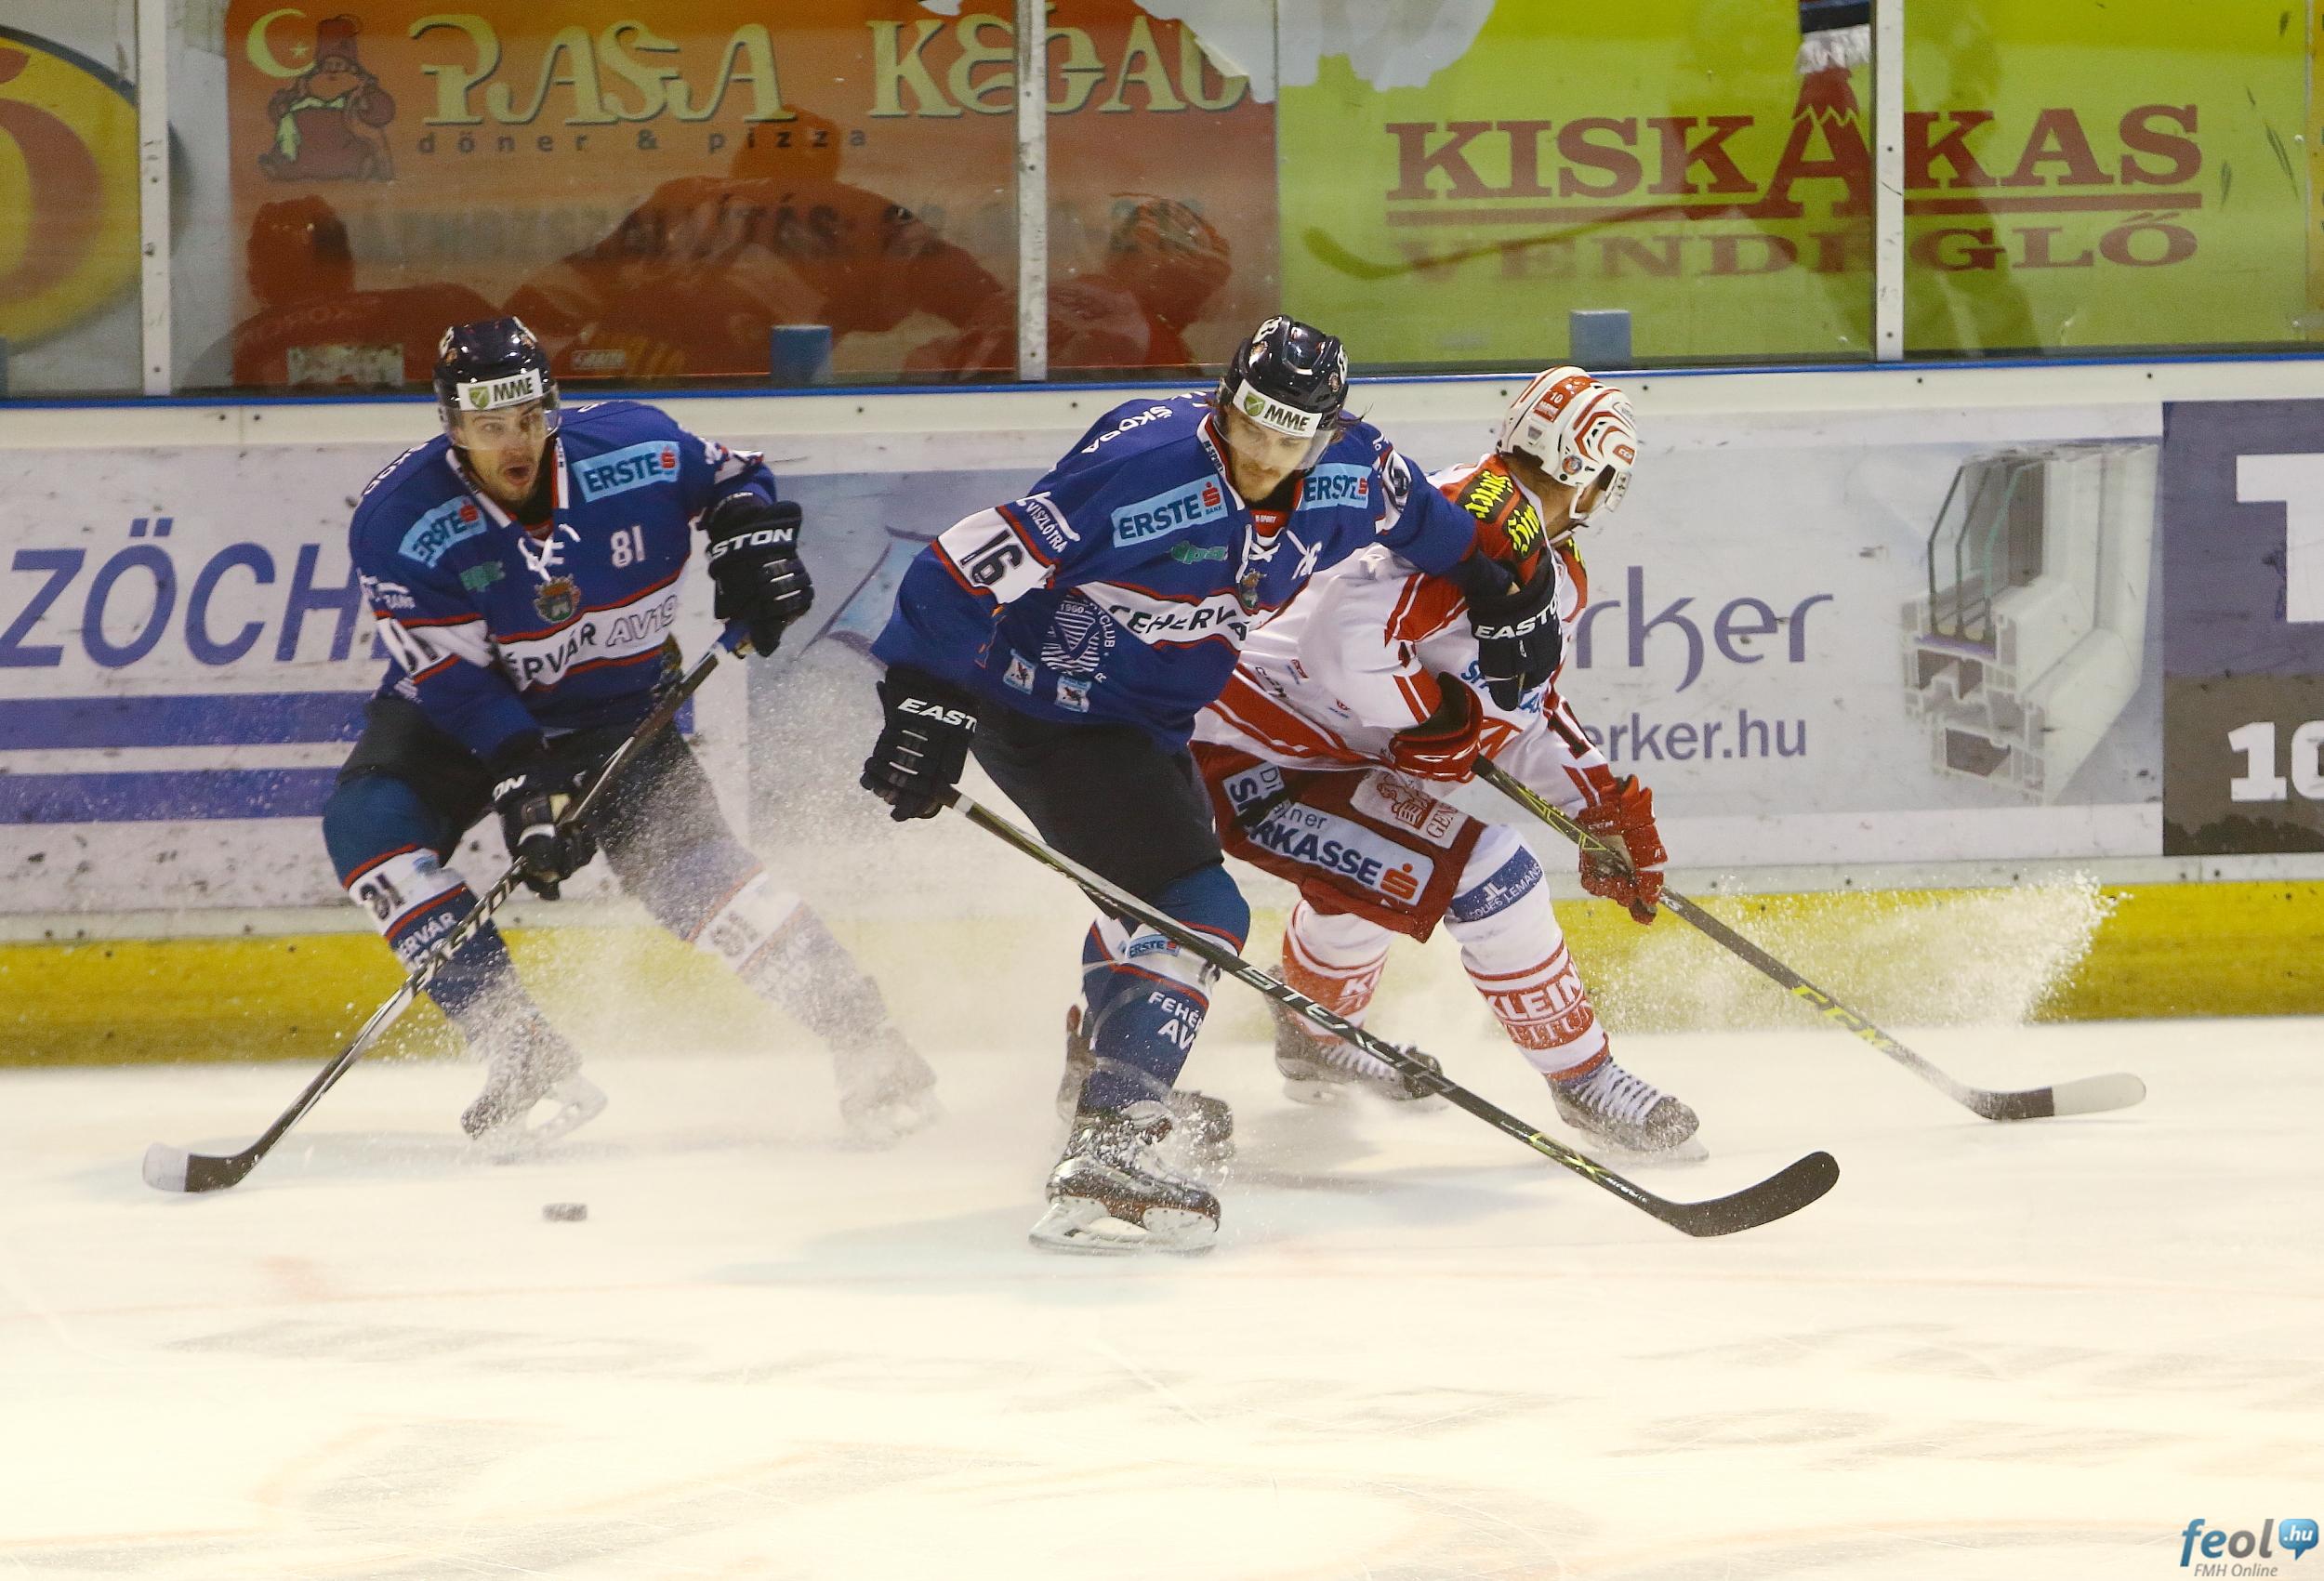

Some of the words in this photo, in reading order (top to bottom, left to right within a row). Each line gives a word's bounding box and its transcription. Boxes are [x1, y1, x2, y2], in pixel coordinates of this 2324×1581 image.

[417, 128, 589, 153] döner
[638, 128, 660, 151] &
[707, 128, 866, 153] pizza
[493, 375, 534, 402] MME
[1263, 403, 1311, 431] MME
[584, 452, 660, 494] ERSTE
[1303, 474, 1359, 503] ERSTE
[1118, 494, 1203, 540] ERSTE
[610, 524, 646, 569] 81
[705, 527, 795, 560] STON
[959, 529, 1023, 586] 16
[0, 517, 391, 669] ZÖCH
[1474, 594, 1558, 640] EASTO
[897, 697, 978, 733] EAST
[1581, 708, 1806, 762] erker.hu
[1129, 940, 1166, 957] ERSTE
